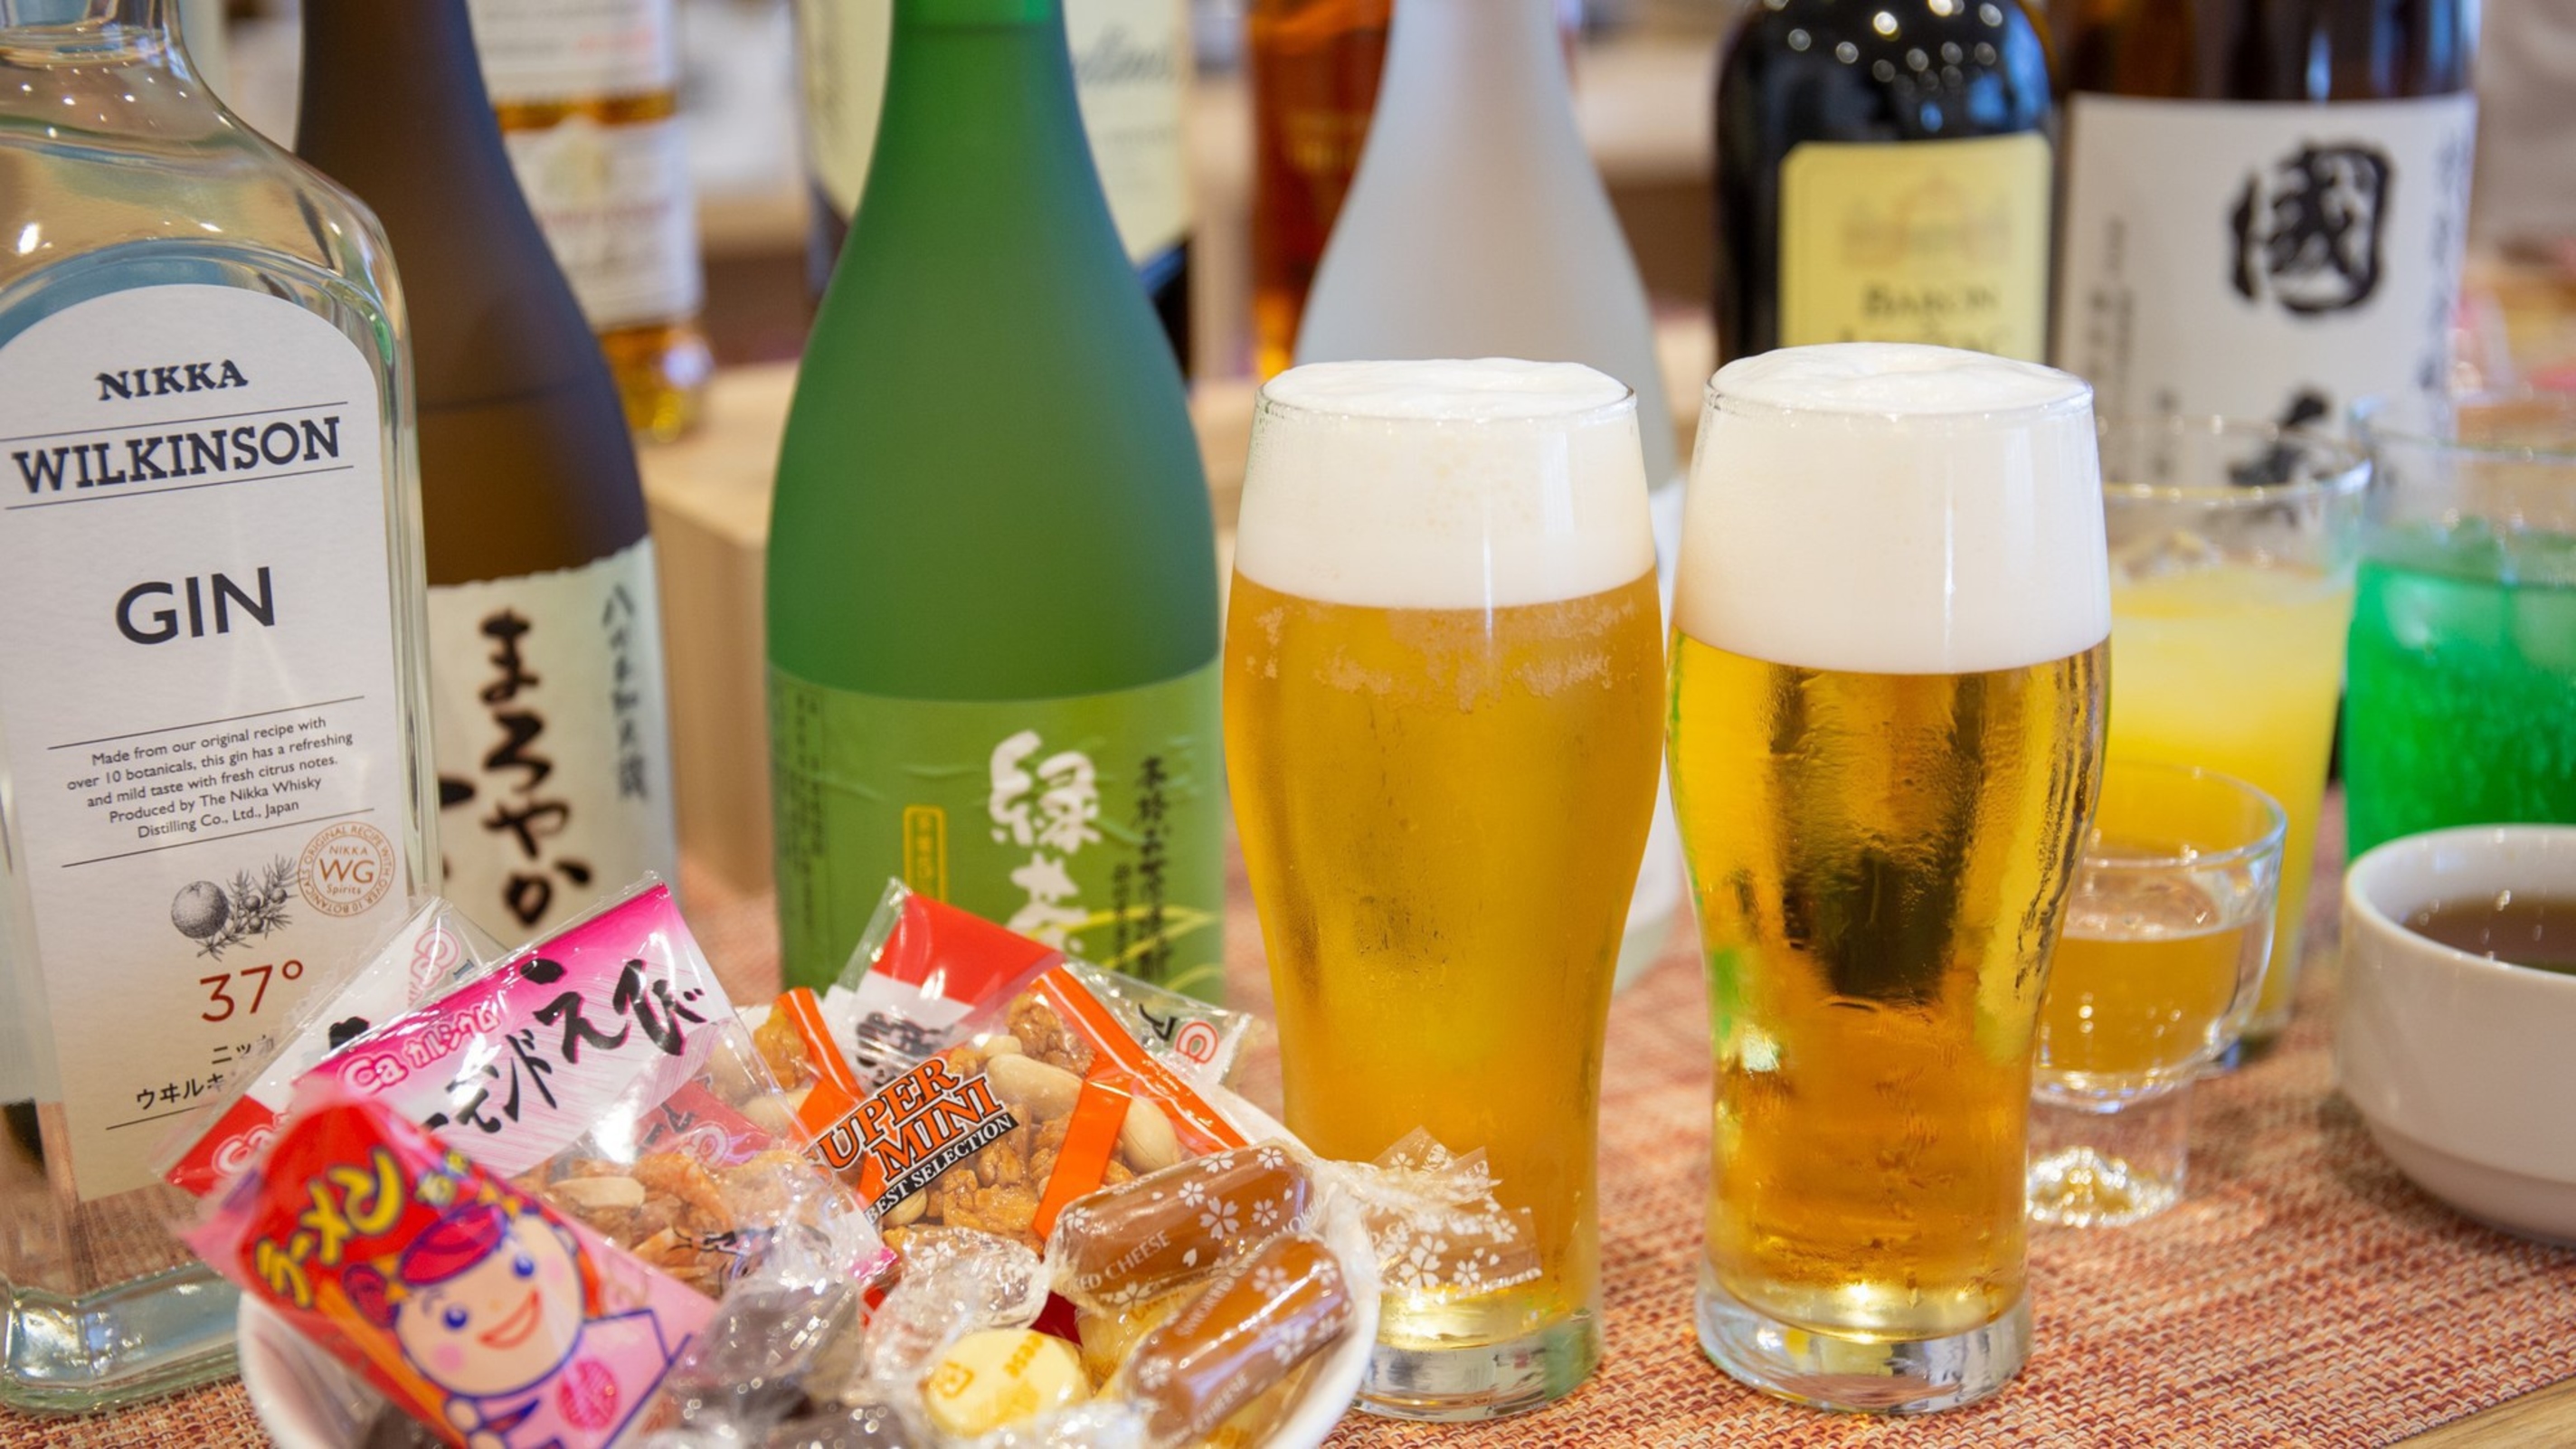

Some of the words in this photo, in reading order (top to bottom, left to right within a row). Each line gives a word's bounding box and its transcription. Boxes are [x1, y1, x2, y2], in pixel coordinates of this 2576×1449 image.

[95, 359, 249, 401] NIKKA
[12, 416, 340, 494] WILKINSON
[116, 566, 275, 645] GIN
[67, 776, 99, 791] over
[106, 770, 121, 783] 10
[126, 759, 197, 781] botanicals,
[201, 754, 224, 768] this
[229, 751, 248, 766] gin
[252, 747, 273, 760] has
[278, 746, 285, 755] a
[289, 733, 354, 753] refreshing
[91, 750, 129, 766] Made
[134, 745, 167, 760] from
[172, 740, 196, 753] our
[201, 729, 249, 748] original
[254, 724, 294, 739] recipe
[298, 716, 327, 732] with
[479, 604, 593, 928] まろやか
[87, 792, 112, 808] and
[117, 786, 146, 802] mild
[150, 782, 184, 797] taste
[187, 775, 217, 789] with
[222, 768, 254, 784] fresh
[259, 763, 295, 778] citrus
[299, 756, 338, 771] notes.
[109, 800, 175, 823] Produced
[179, 799, 195, 813] by
[199, 794, 226, 807] The
[231, 786, 269, 802] Nikka
[272, 777, 322, 794] Whisky
[137, 819, 197, 838] Distilling
[200, 813, 229, 827] Co.,
[232, 807, 261, 822] Ltd.,
[265, 800, 299, 819] Japan
[304, 826, 346, 865] ORIGINAL
[319, 857, 374, 884] WG
[329, 845, 368, 856] NIKKA
[327, 884, 362, 895] Spirits
[817, 1059, 961, 1170] UPER
[871, 1075, 1004, 1181] MINI
[865, 1182, 910, 1225] BEST
[909, 1115, 1014, 1189] SELECTION
[1105, 1230, 1171, 1280] CHEESE
